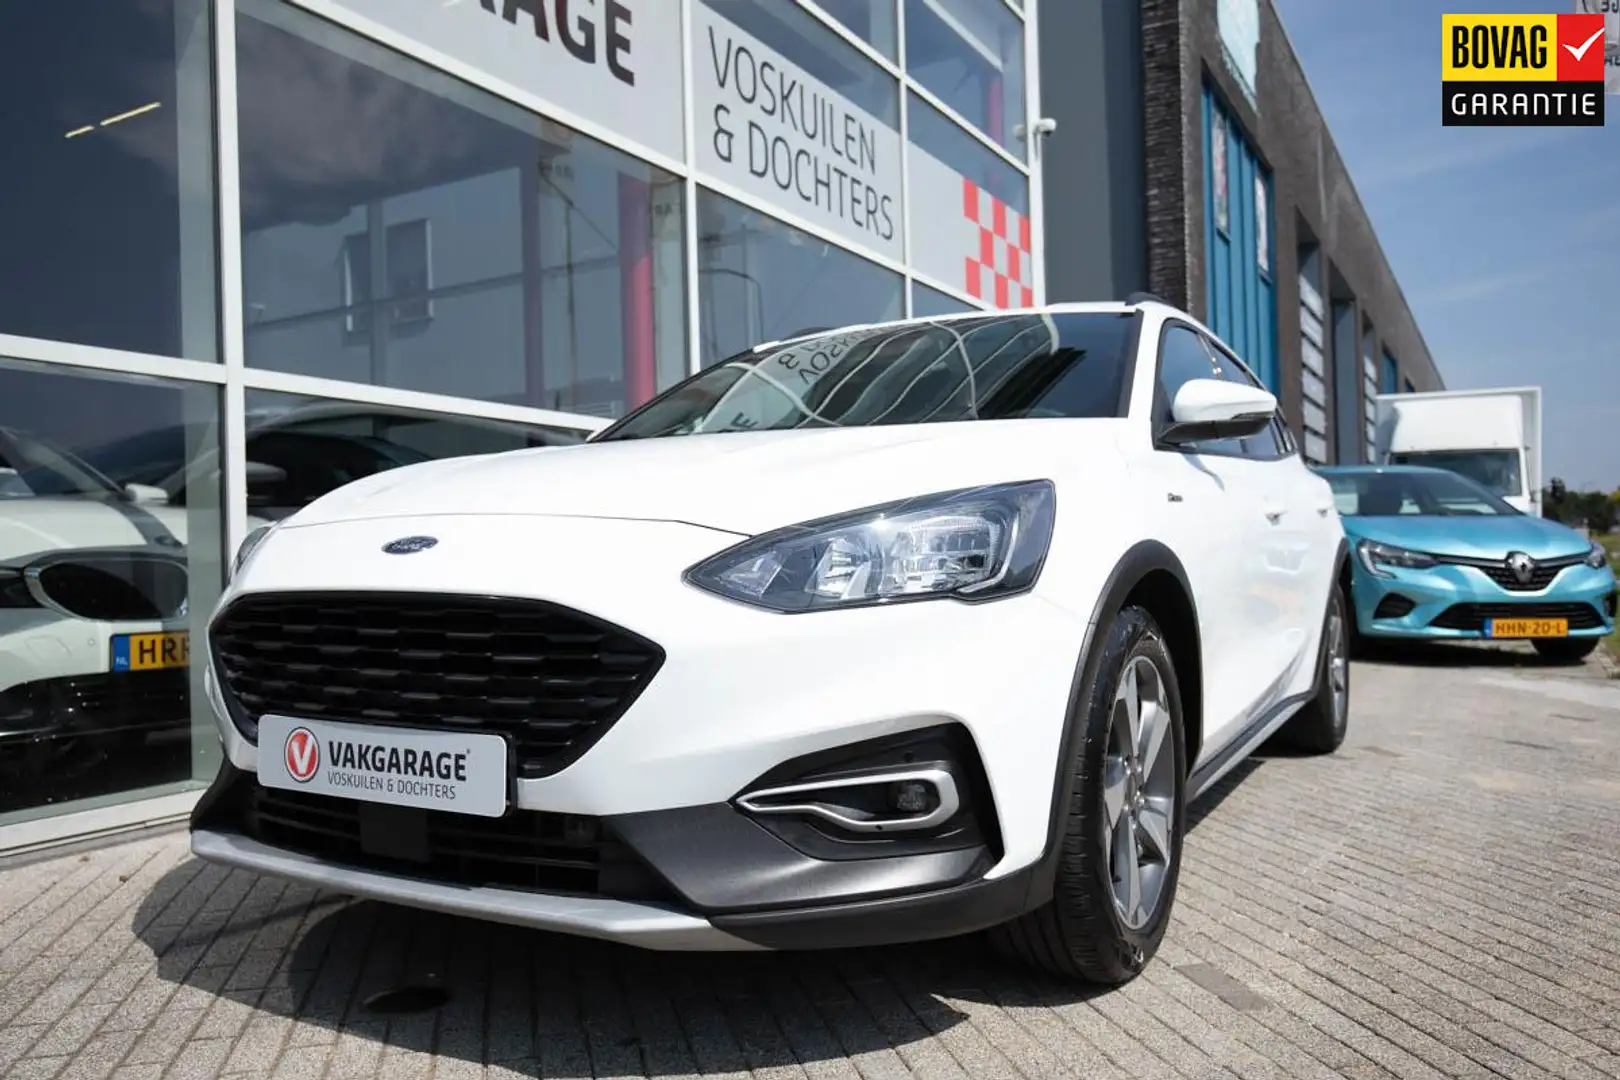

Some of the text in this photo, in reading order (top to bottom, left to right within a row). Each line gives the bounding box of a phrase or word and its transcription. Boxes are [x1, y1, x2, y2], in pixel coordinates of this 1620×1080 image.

[708, 25, 876, 176] VOSKUILEN
[713, 104, 894, 241] & DOCHTERS
[327, 770, 457, 800] VOSKUILEN & DOCHTERS
